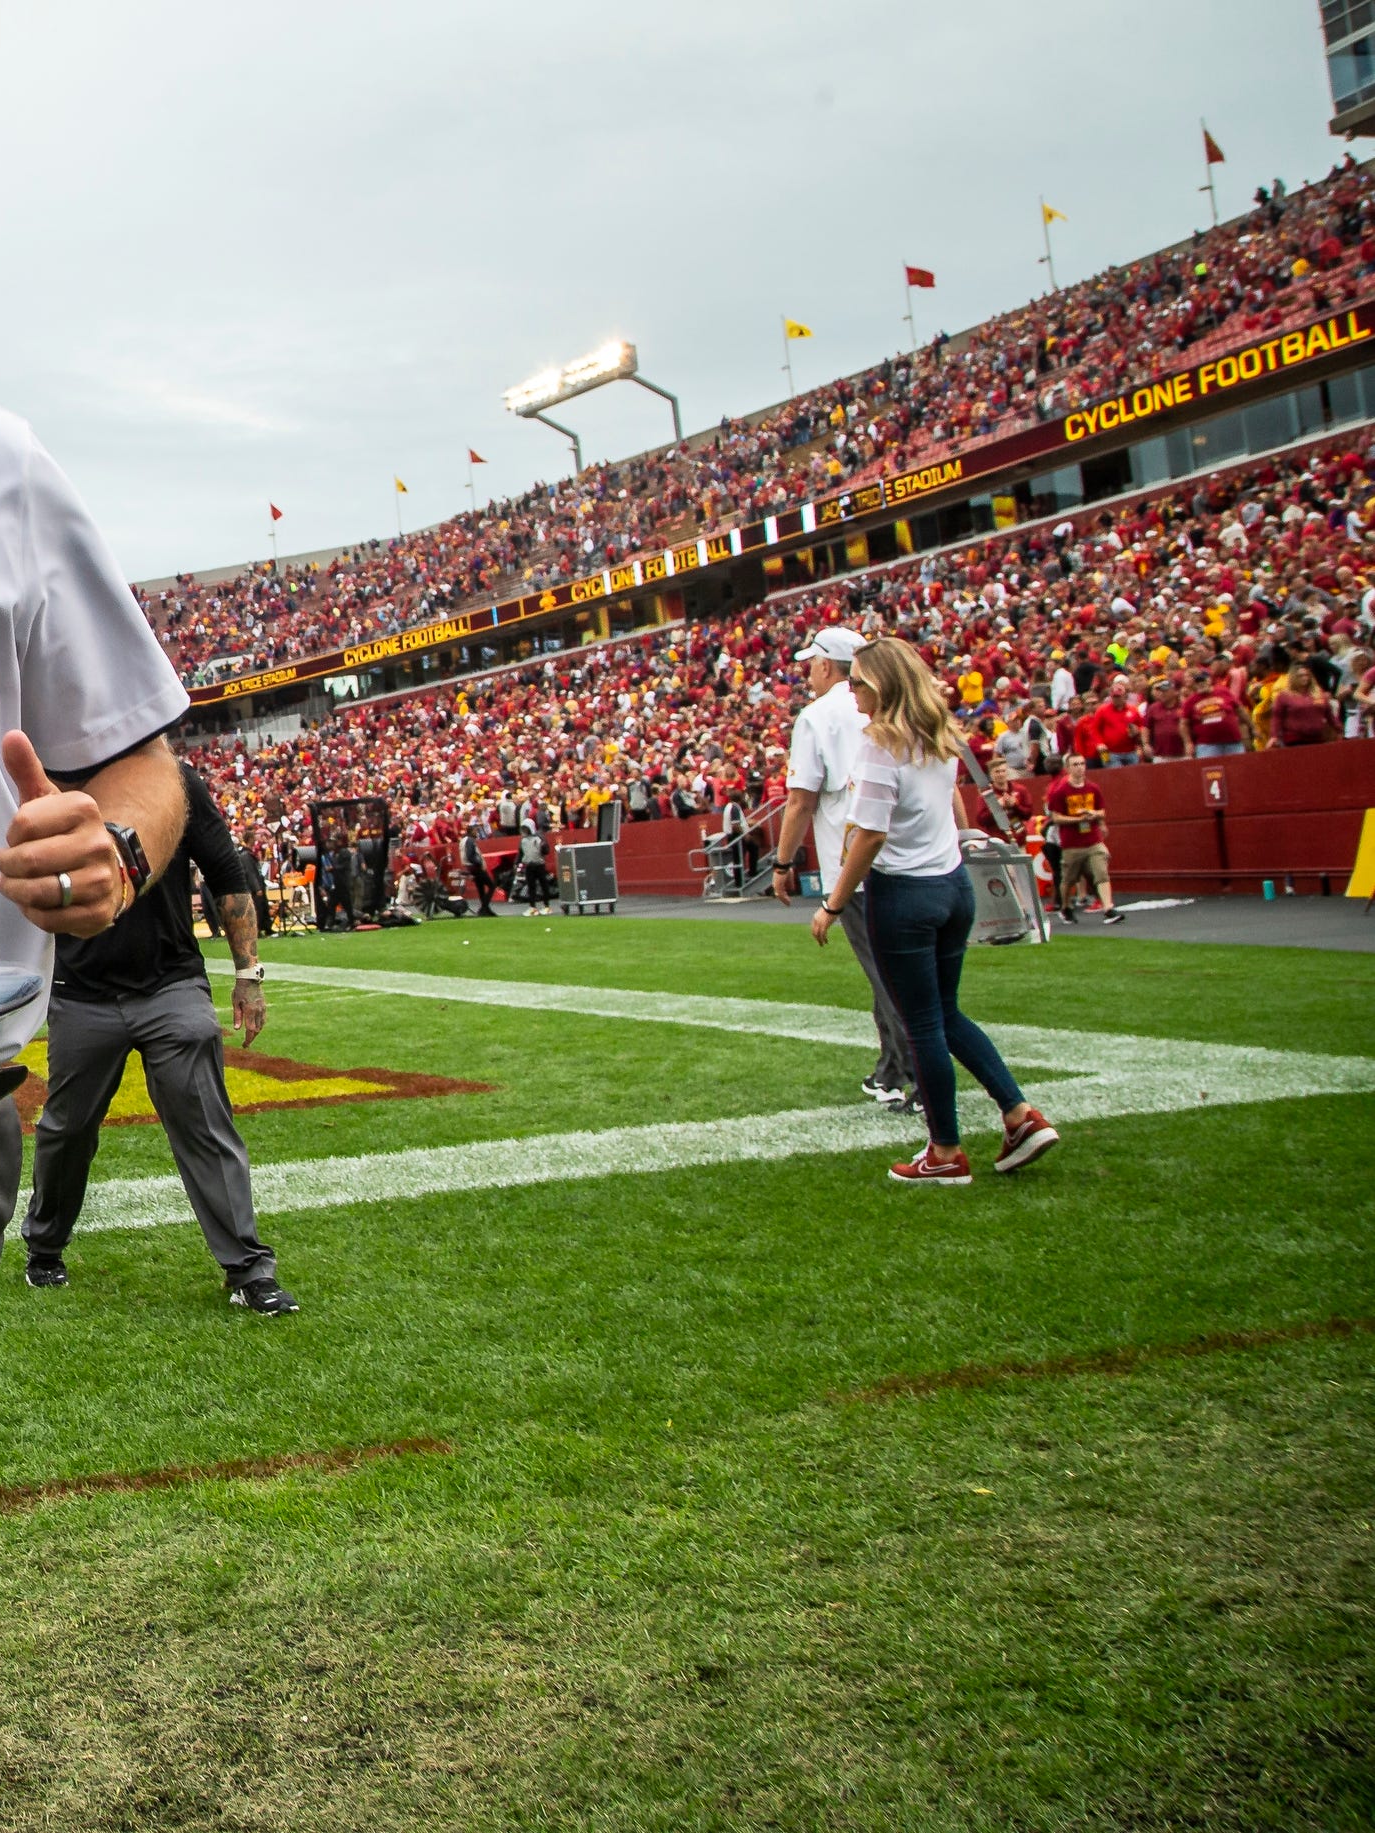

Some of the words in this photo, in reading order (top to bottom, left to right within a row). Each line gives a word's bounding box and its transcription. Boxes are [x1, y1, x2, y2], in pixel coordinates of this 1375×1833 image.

[1064, 373, 1193, 442] CYCLONE
[1198, 311, 1372, 395] FOOTBALL
[894, 459, 962, 499] STADIUM
[344, 636, 401, 667] CYCLONE
[402, 618, 468, 649] FOOTBALL
[1210, 780, 1220, 799] 4
